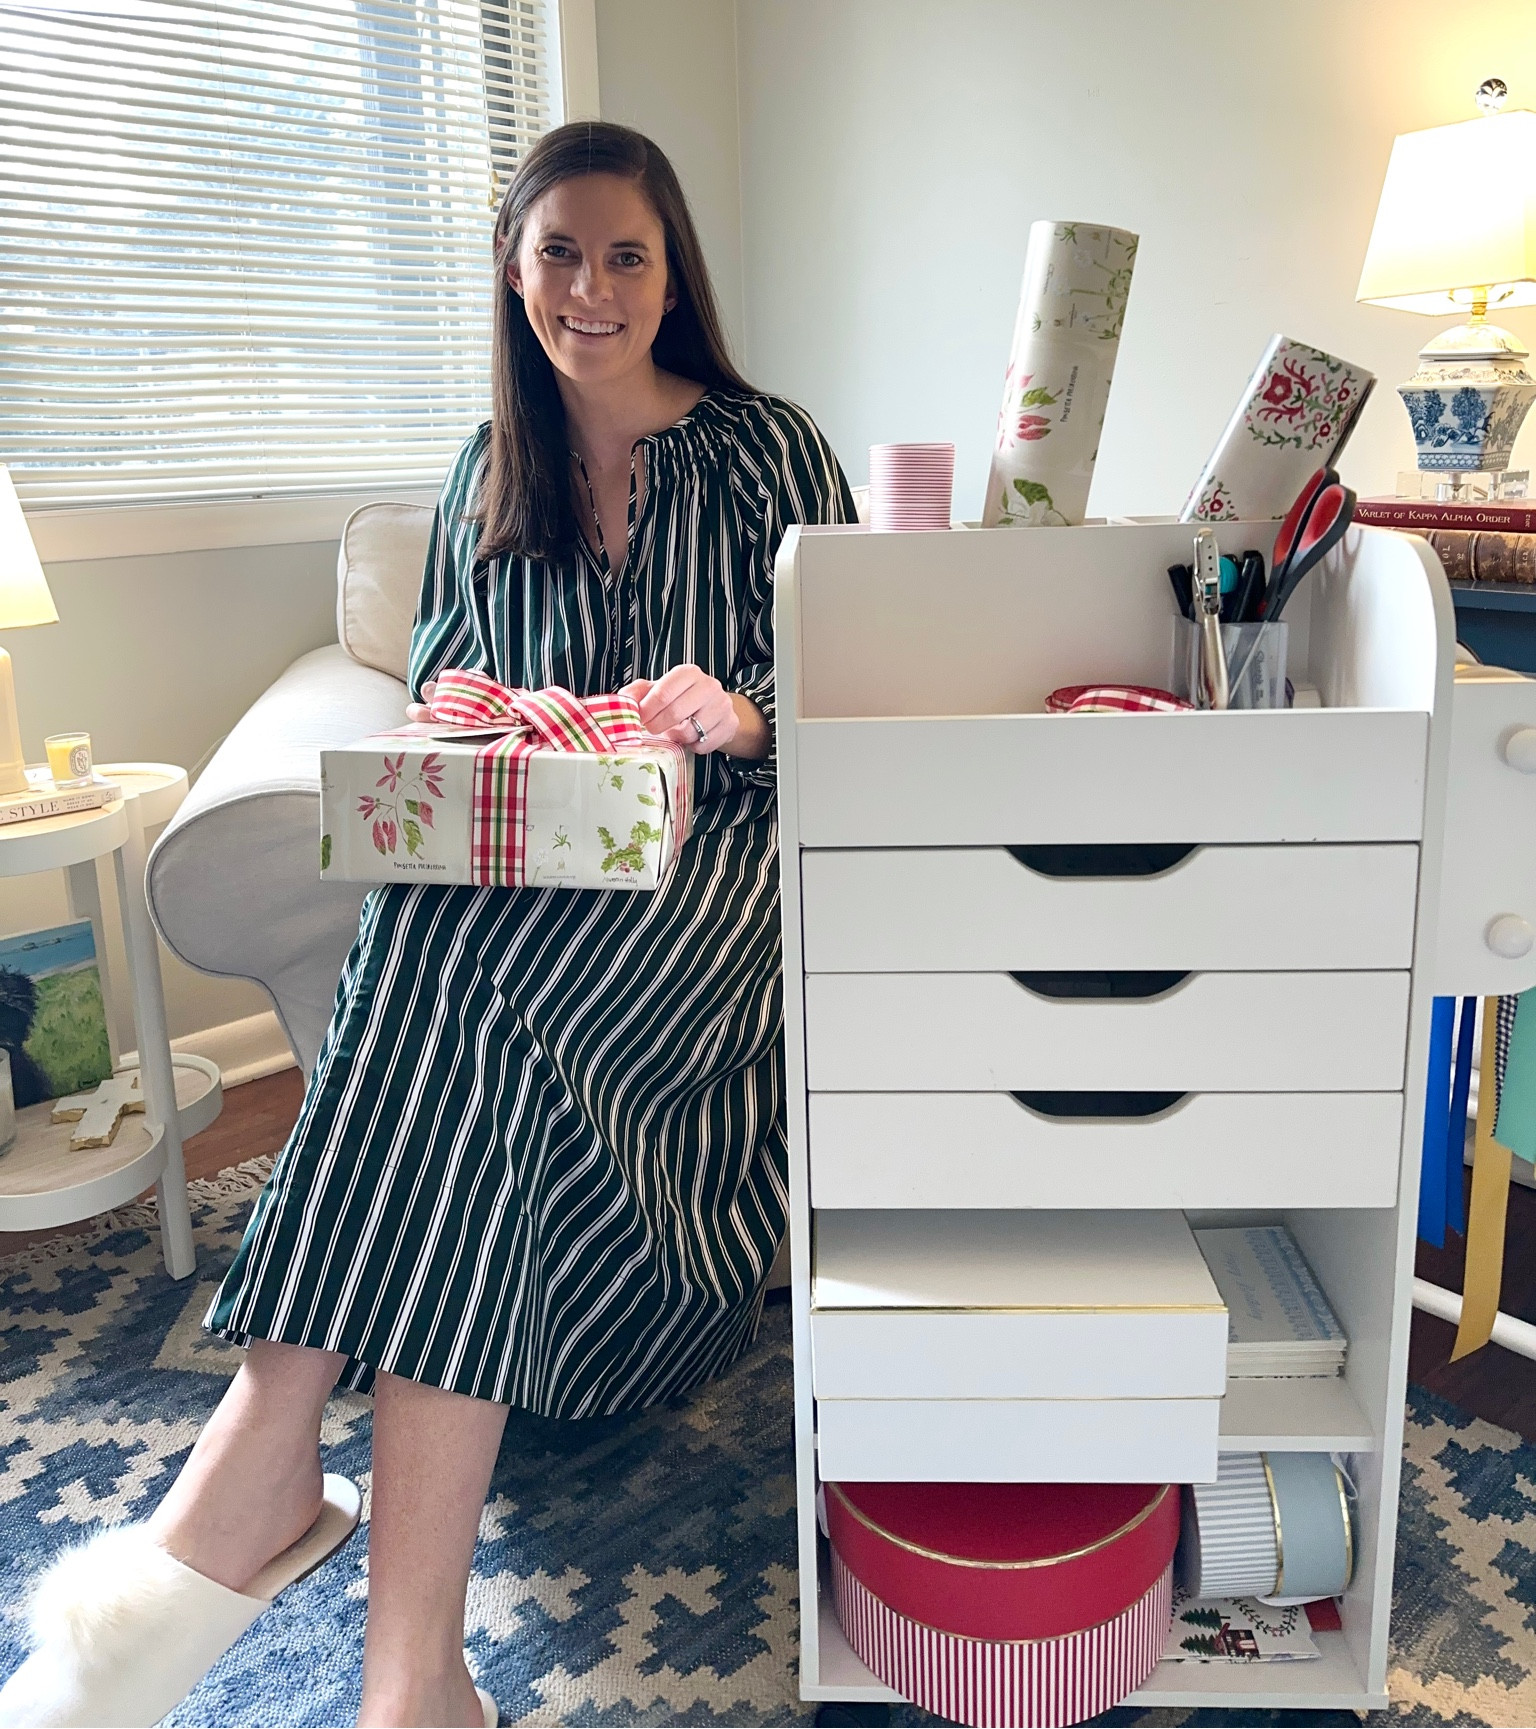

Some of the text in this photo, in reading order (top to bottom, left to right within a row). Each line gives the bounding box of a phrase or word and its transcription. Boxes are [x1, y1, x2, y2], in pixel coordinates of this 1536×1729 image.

[1358, 509, 1391, 519] VARLET
[1408, 510, 1438, 520] KAPPA
[1441, 512, 1473, 522] ALPHA
[1476, 513, 1511, 524] ORDER
[9, 800, 60, 819] STYLE
